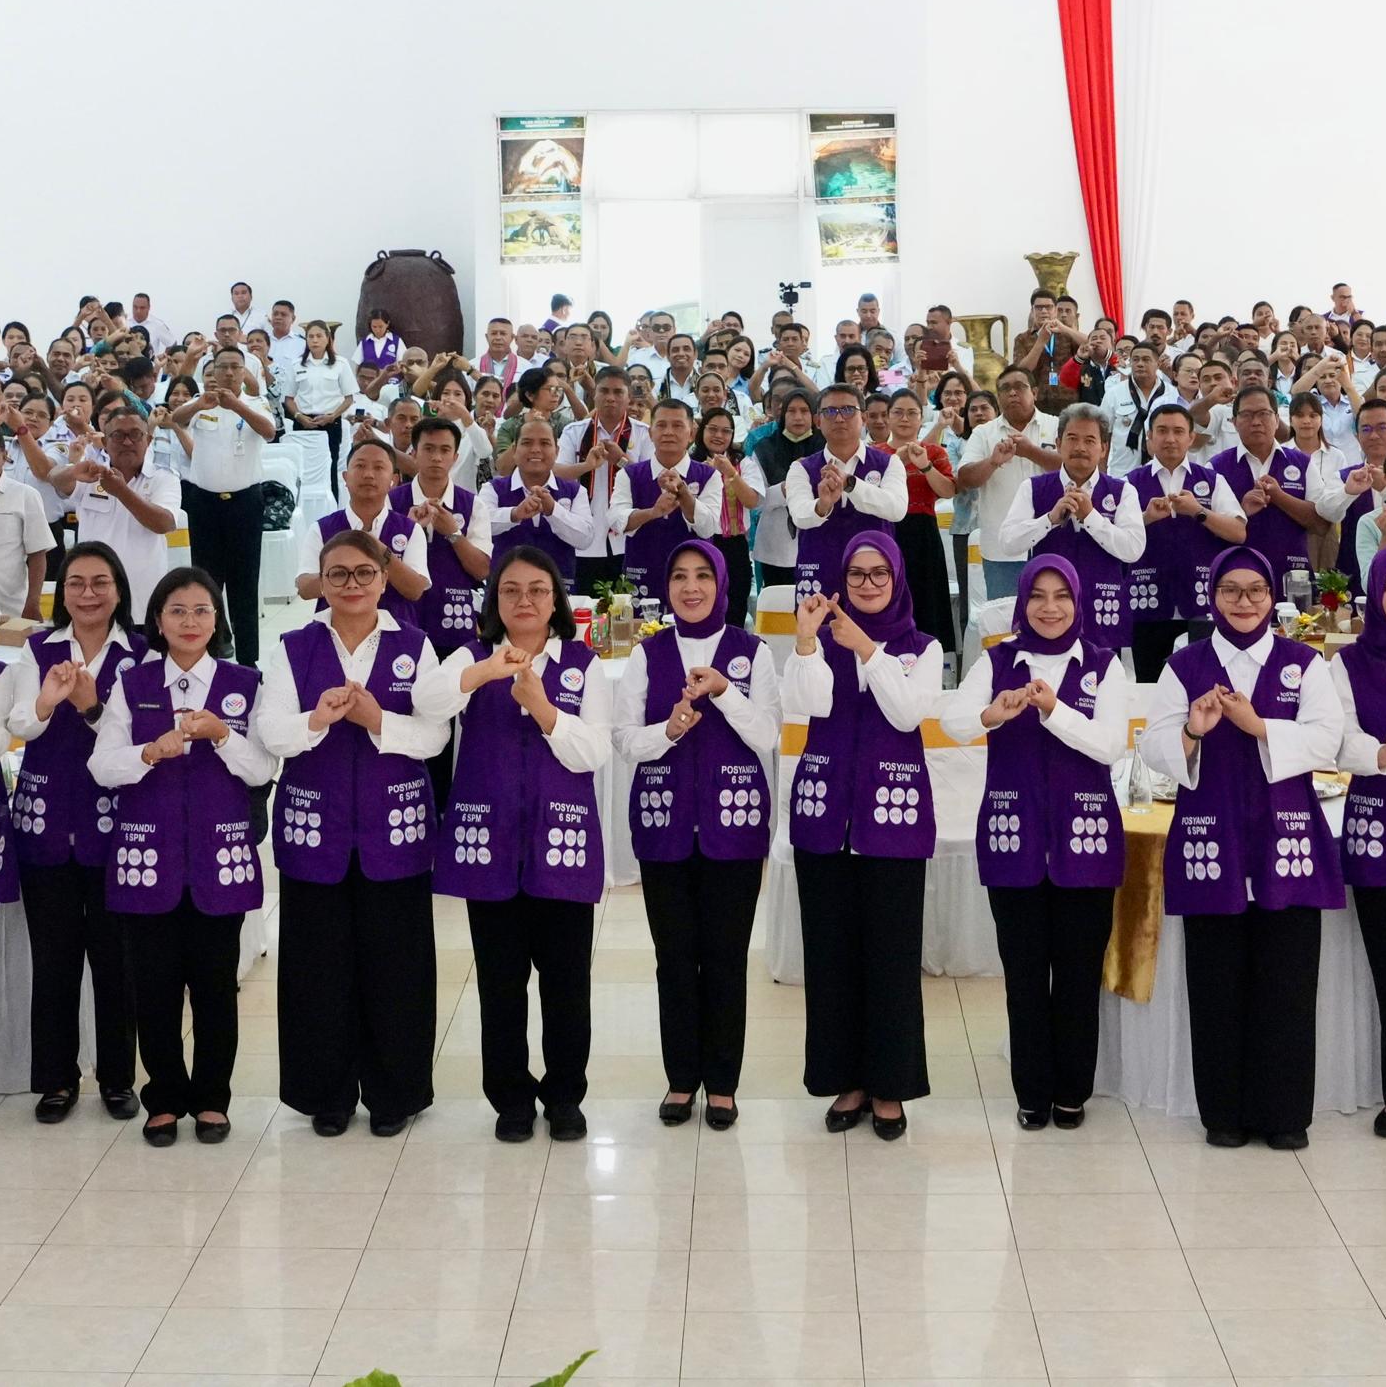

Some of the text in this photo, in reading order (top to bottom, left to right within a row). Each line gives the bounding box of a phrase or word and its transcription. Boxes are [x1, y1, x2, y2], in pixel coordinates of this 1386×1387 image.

[722, 765, 757, 774] POSYANDU
[879, 761, 920, 773] POSYANDU
[650, 775, 663, 784] SPM
[896, 773, 911, 782] SPM
[388, 778, 425, 794] POSYANDU
[286, 784, 321, 800] POSYANDU
[405, 790, 420, 800] SPM
[1074, 792, 1107, 802] POSYANDU
[295, 798, 311, 808] SPM
[455, 803, 490, 813] POSYANDU
[550, 801, 588, 815] POSYANDU
[1359, 806, 1373, 815] SPM
[468, 814, 482, 822] SPM
[1182, 816, 1216, 825] POSYANDU
[1276, 812, 1310, 821] POSYANDU
[216, 822, 249, 833] POSYANDU
[1192, 826, 1207, 835] SPM
[1290, 822, 1305, 830] SPM
[129, 833, 145, 842] SPM
